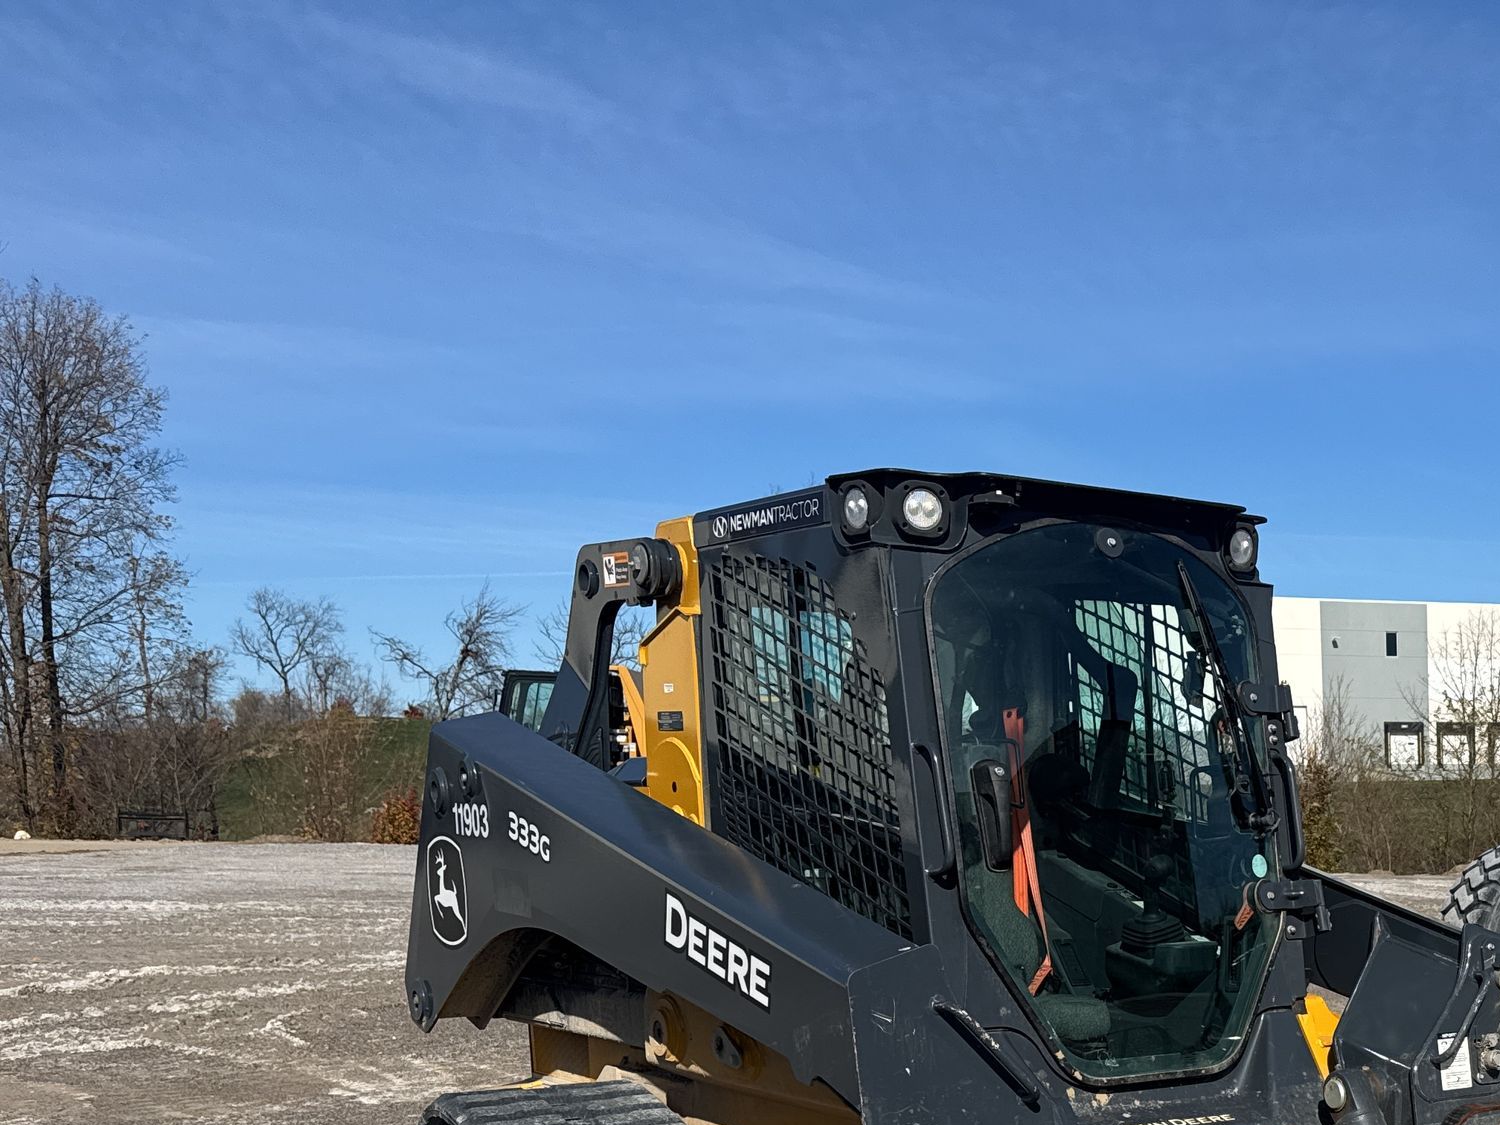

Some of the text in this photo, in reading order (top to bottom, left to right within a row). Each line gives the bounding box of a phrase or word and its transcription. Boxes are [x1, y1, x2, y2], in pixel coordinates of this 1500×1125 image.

[452, 802, 490, 839] 11903
[508, 811, 550, 862] 333G
[665, 892, 771, 1008] DEERE
